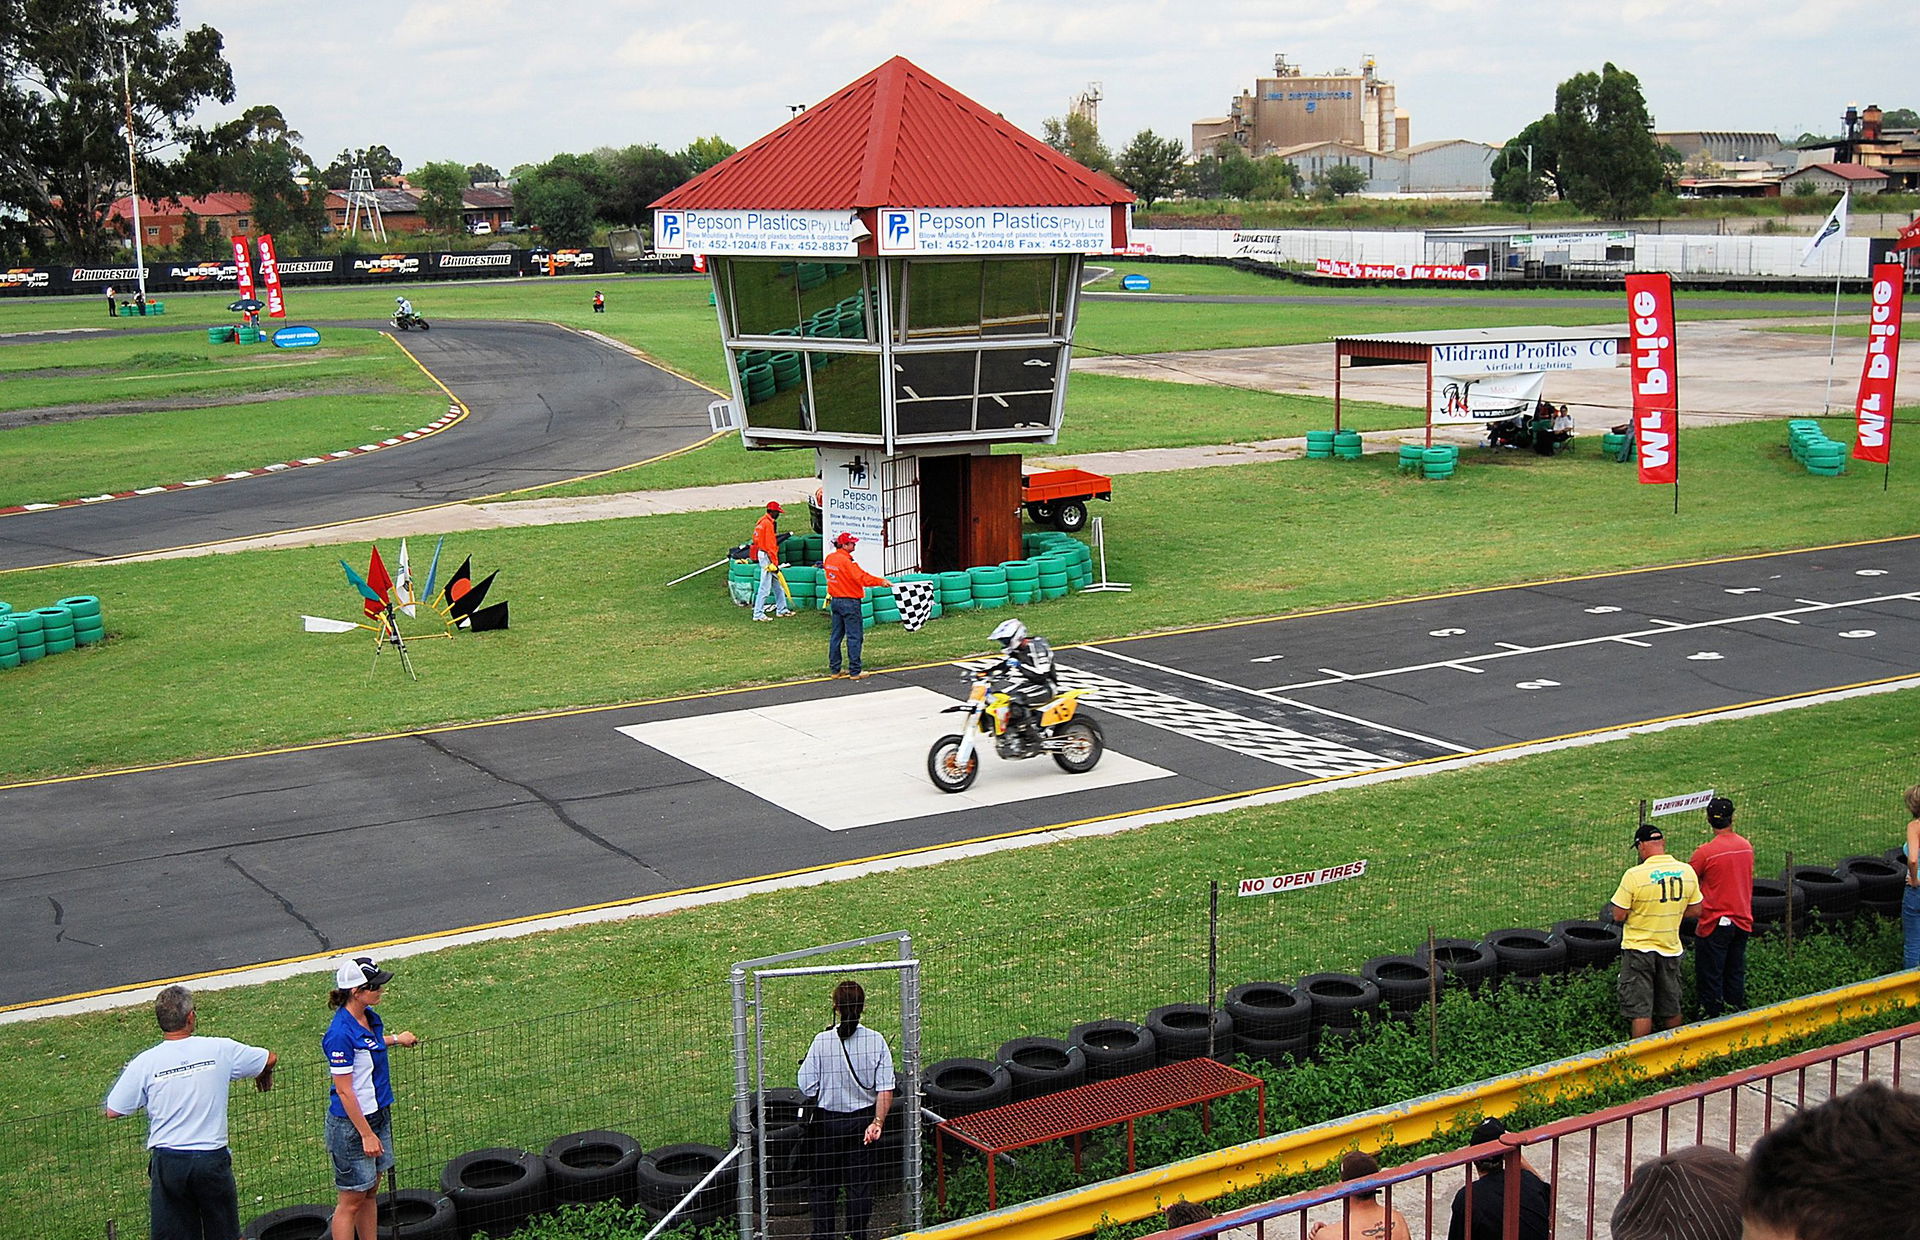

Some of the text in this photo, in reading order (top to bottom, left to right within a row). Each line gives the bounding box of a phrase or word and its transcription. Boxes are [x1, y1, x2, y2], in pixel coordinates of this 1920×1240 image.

[686, 213, 742, 234] Pepson
[834, 219, 850, 232] Ltd
[919, 212, 985, 233] Pepson
[1088, 218, 1105, 229] Ltd
[701, 232, 727, 240] Moulding
[735, 233, 758, 241] Printing
[938, 232, 969, 240] Moulding
[1015, 231, 1038, 239] plastic
[1233, 233, 1281, 243] BRIDGESTONE
[686, 240, 849, 251] Tel: 452-1204/8 Fax: 452-8837
[920, 239, 1105, 249] Tel: 452-1204/8 Fax: 452-8837
[440, 255, 511, 267] BRIDGESTONE
[1365, 266, 1395, 278] Price
[1414, 267, 1465, 279] Mr Price
[1435, 340, 1616, 362] Midrand Profiles CC
[1485, 361, 1573, 372] Airfield Lighting
[843, 489, 878, 502] Pepson
[1655, 803, 1663, 811] NO
[1663, 800, 1684, 810] DRIVING
[1690, 797, 1699, 805] PIT
[1241, 861, 1363, 893] NO OPEN FIRES
[1658, 877, 1683, 903] 10
